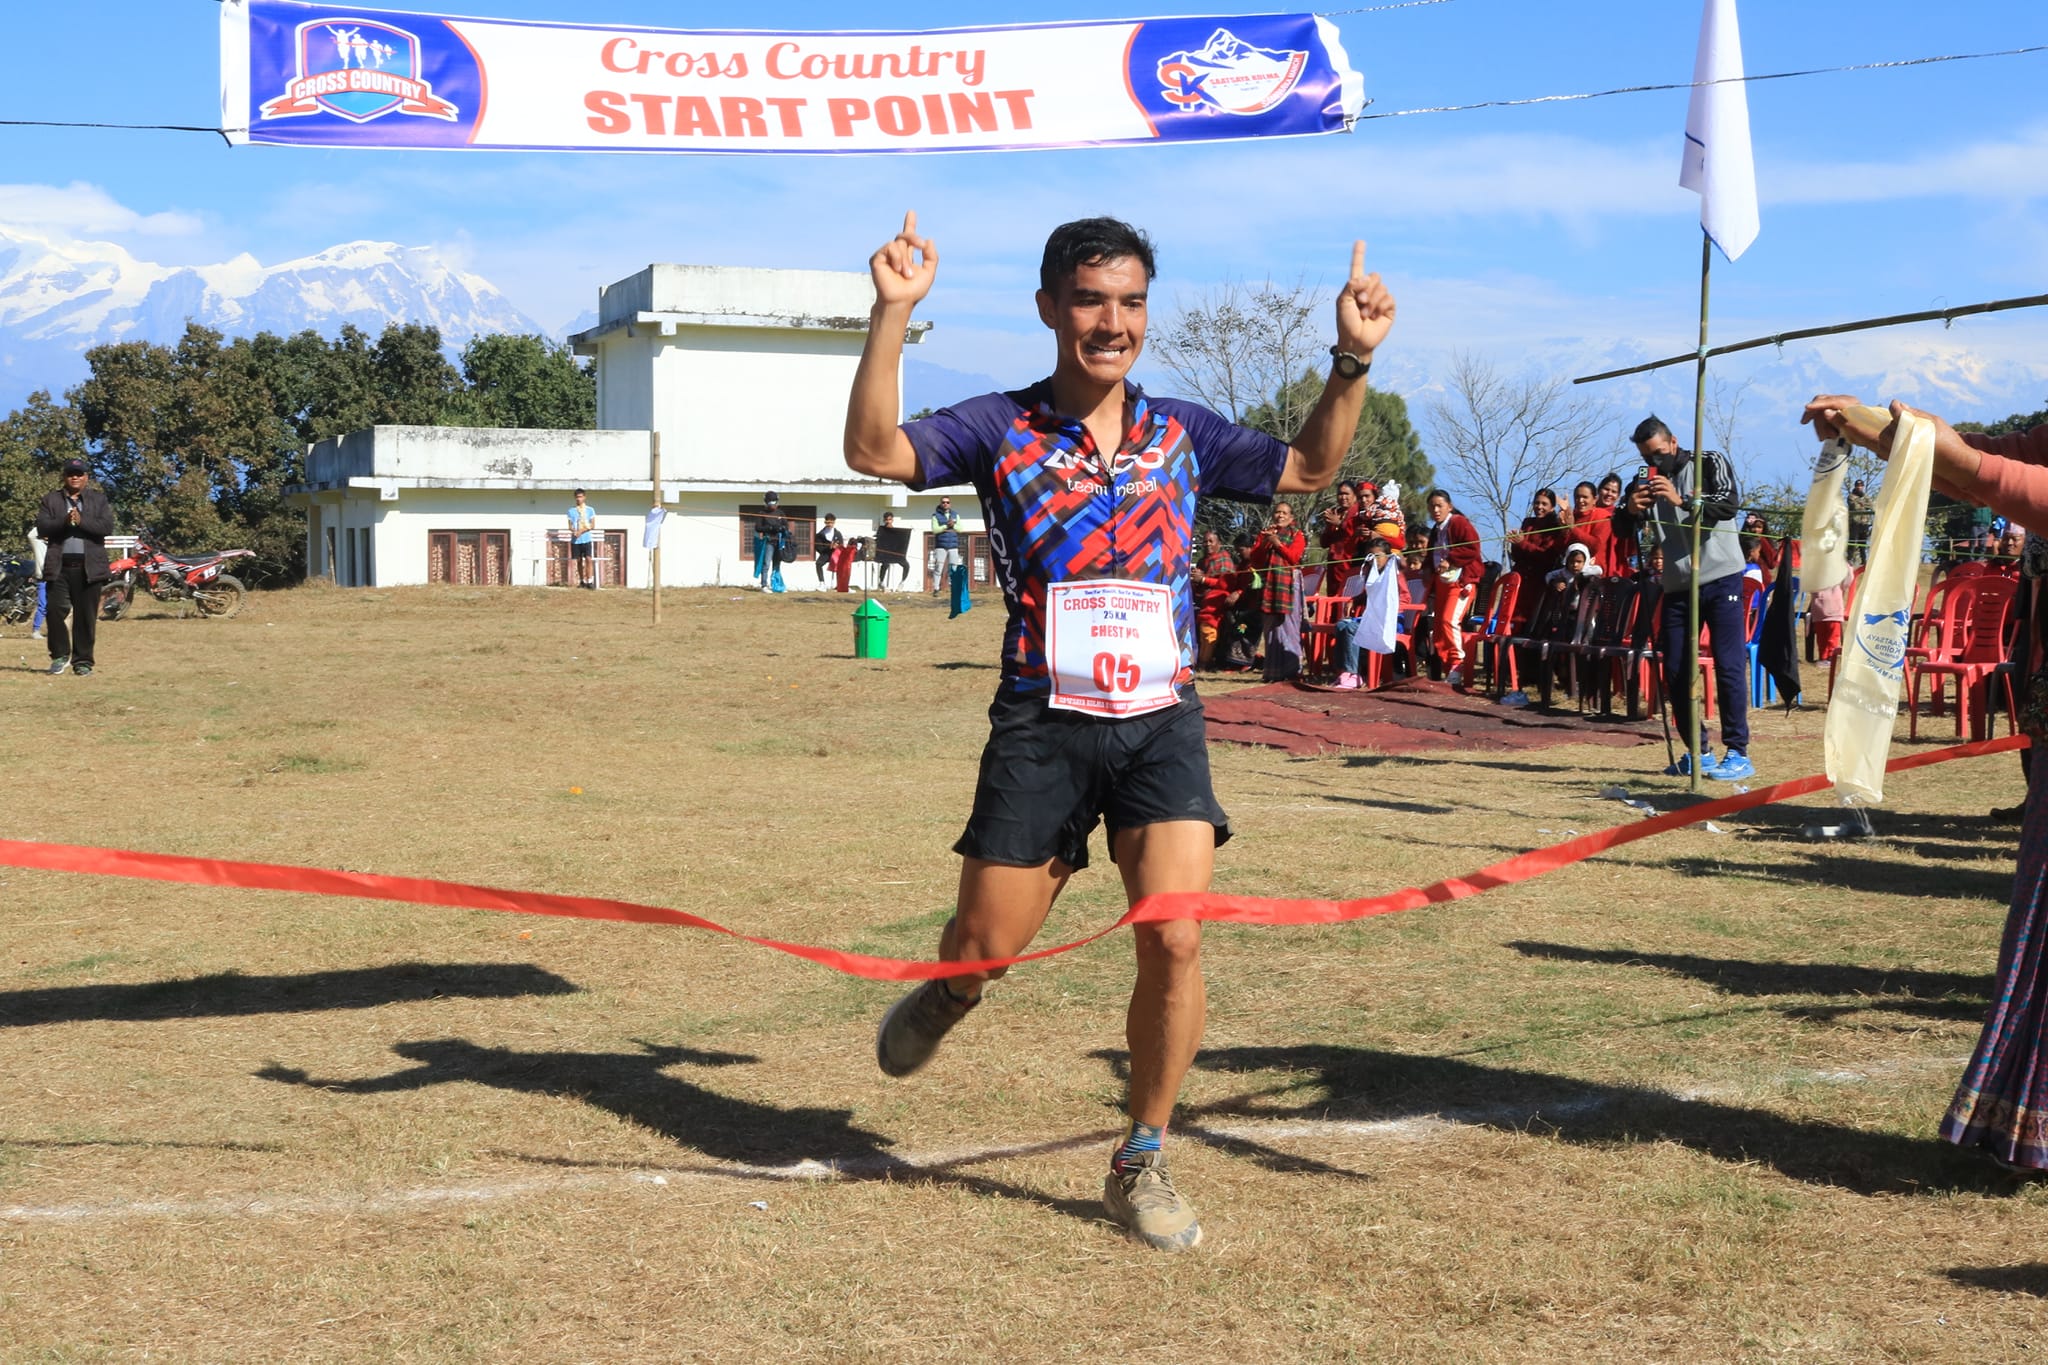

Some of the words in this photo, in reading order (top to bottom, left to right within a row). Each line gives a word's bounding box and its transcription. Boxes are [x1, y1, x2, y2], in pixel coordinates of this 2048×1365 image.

[601, 37, 749, 80] Cross
[765, 42, 985, 87] Country
[295, 71, 347, 99] CROSS
[350, 70, 422, 99] COUNTRY
[584, 90, 808, 138] START
[828, 89, 1036, 138] POINT
[1067, 477, 1109, 497] team
[1116, 477, 1158, 501] nepal
[1064, 596, 1106, 611] CROSS
[1111, 597, 1160, 613] COUNTRY
[1103, 611, 1114, 620] 25
[1091, 625, 1125, 638] CHEST
[1092, 651, 1142, 693] 05
